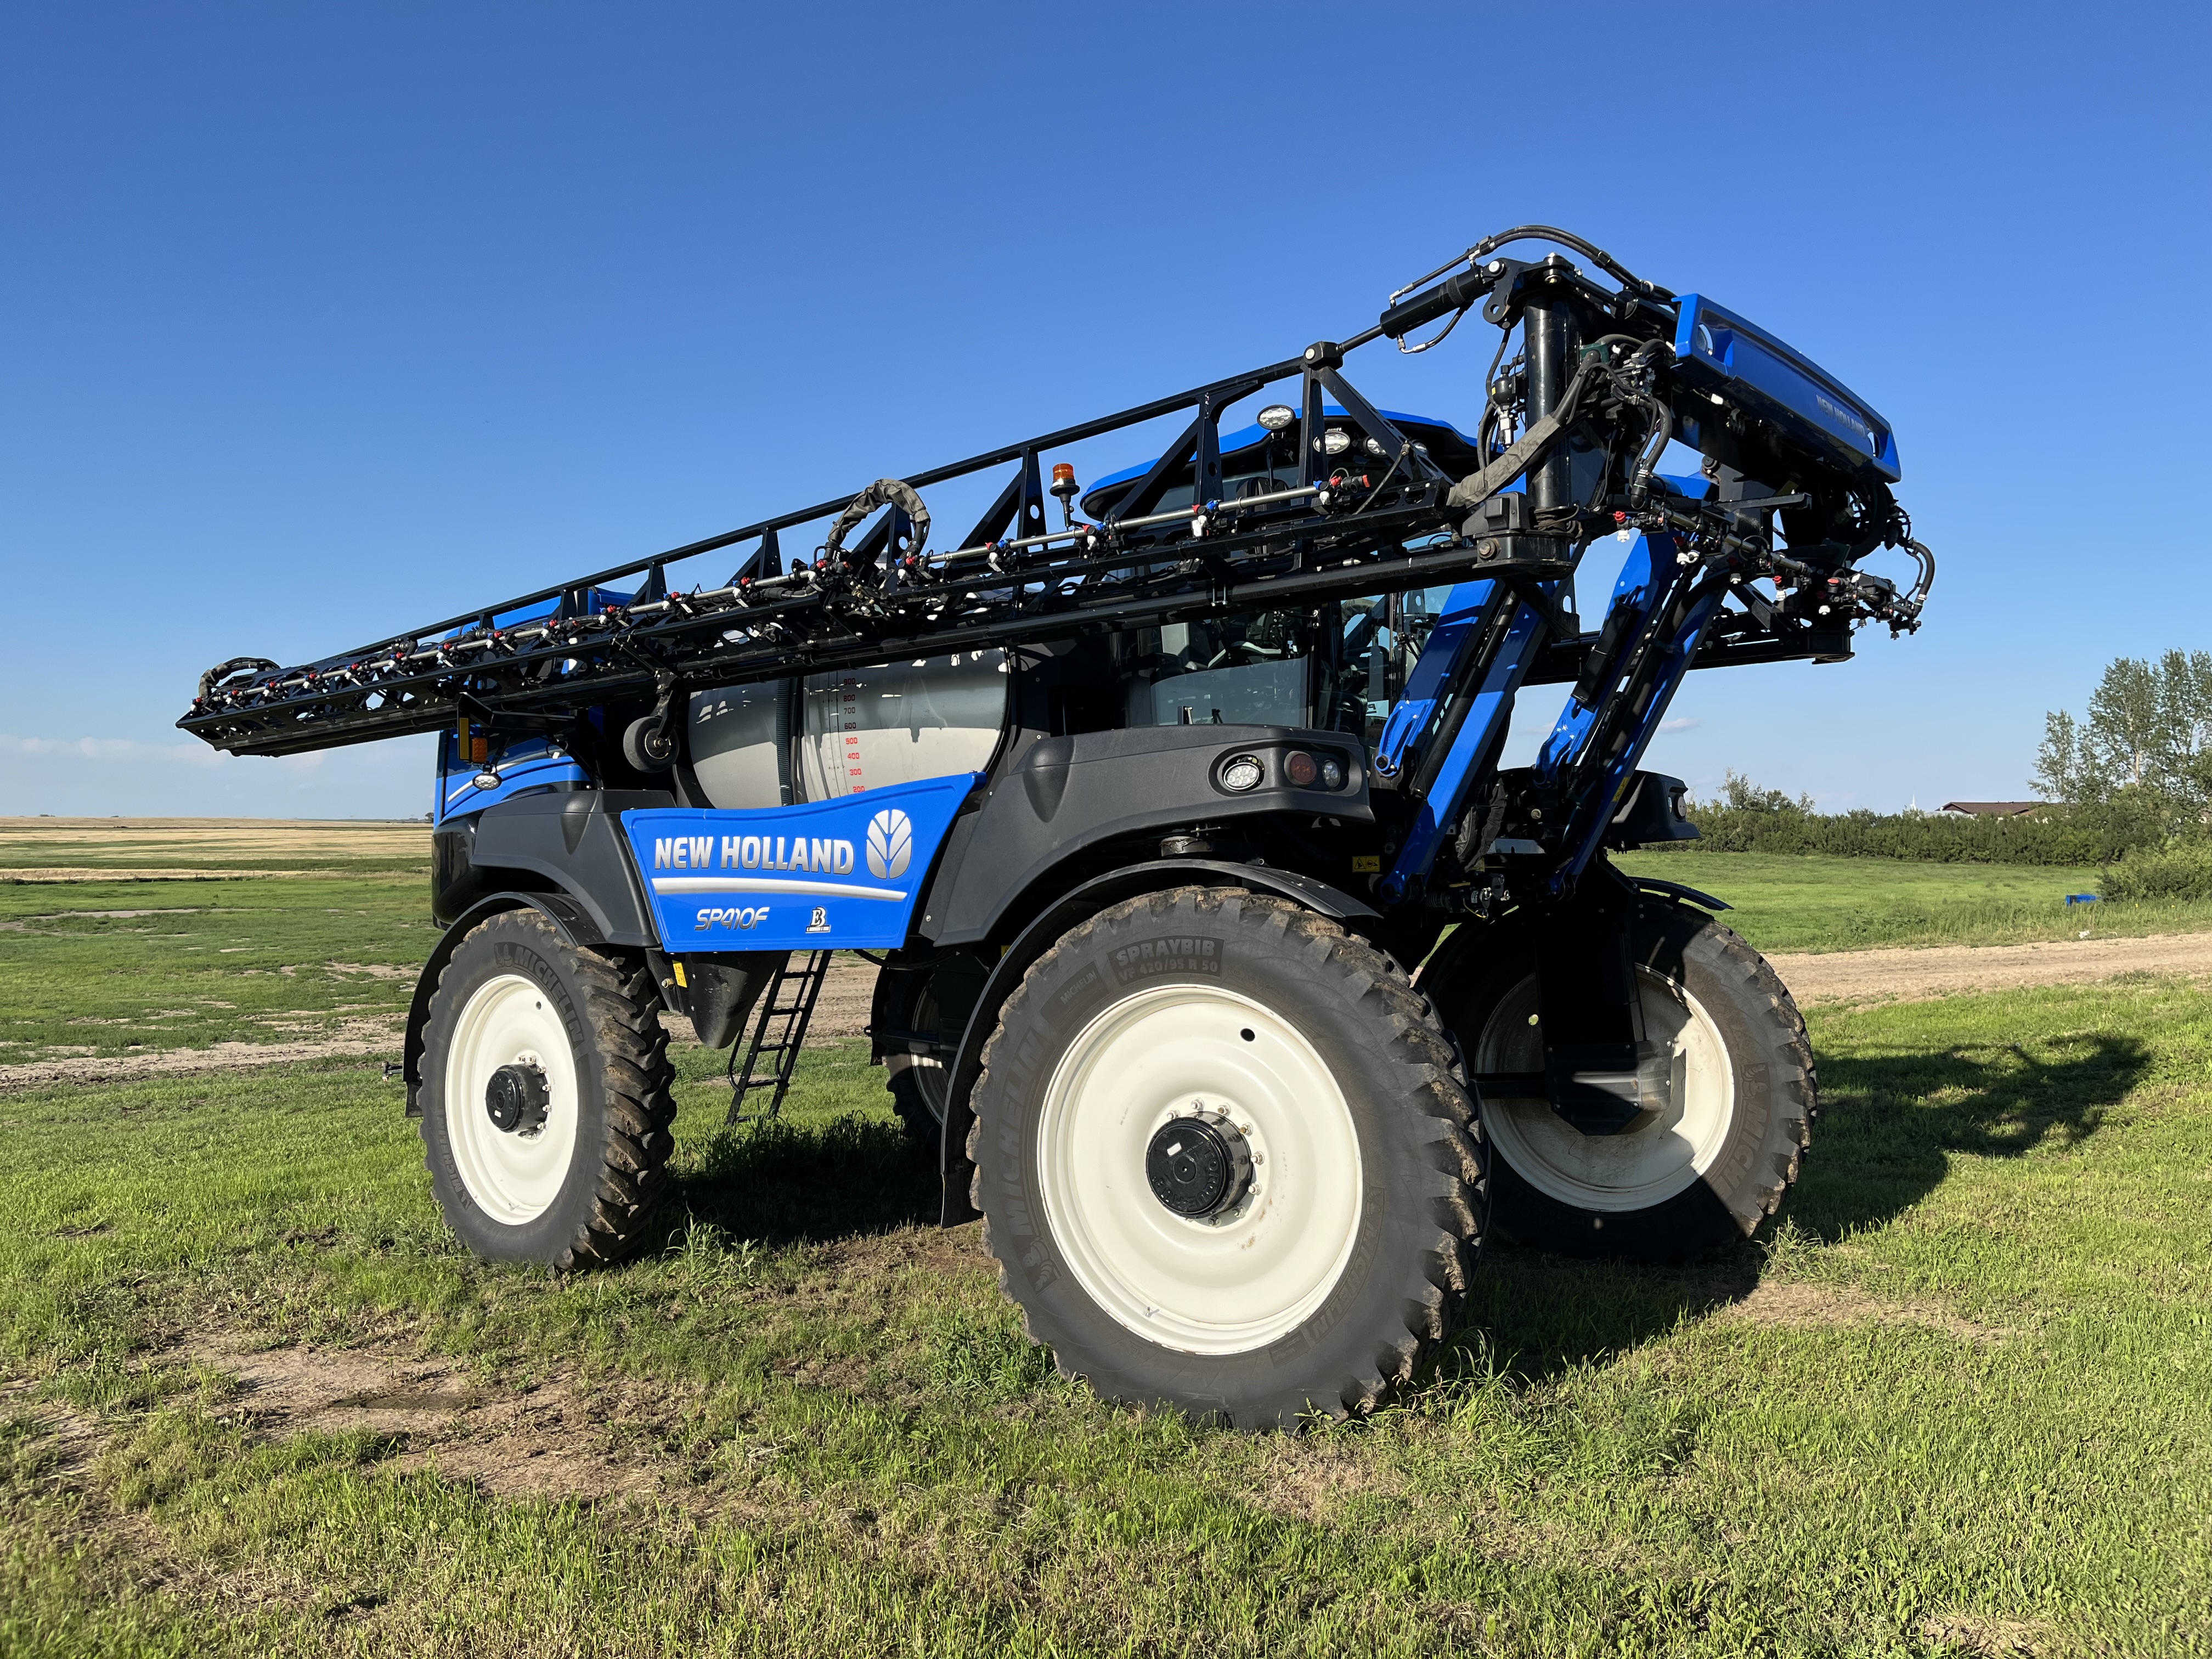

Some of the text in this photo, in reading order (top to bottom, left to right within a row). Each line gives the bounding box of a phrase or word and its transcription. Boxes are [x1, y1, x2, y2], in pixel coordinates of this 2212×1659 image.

[843, 694, 855, 702] 800
[844, 707, 856, 715] 700
[845, 737, 858, 745] 500
[849, 768, 862, 776] 300
[654, 836, 855, 875] NEW HOLLAND
[695, 907, 770, 930] SP410F
[1116, 939, 1216, 967] SPRAYBIB
[1119, 958, 1218, 981] VF 420/95 R 50
[515, 946, 585, 1043] MICHELIN
[1059, 969, 1098, 1005] MICHELIN
[998, 1024, 1045, 1236] MICHELIN
